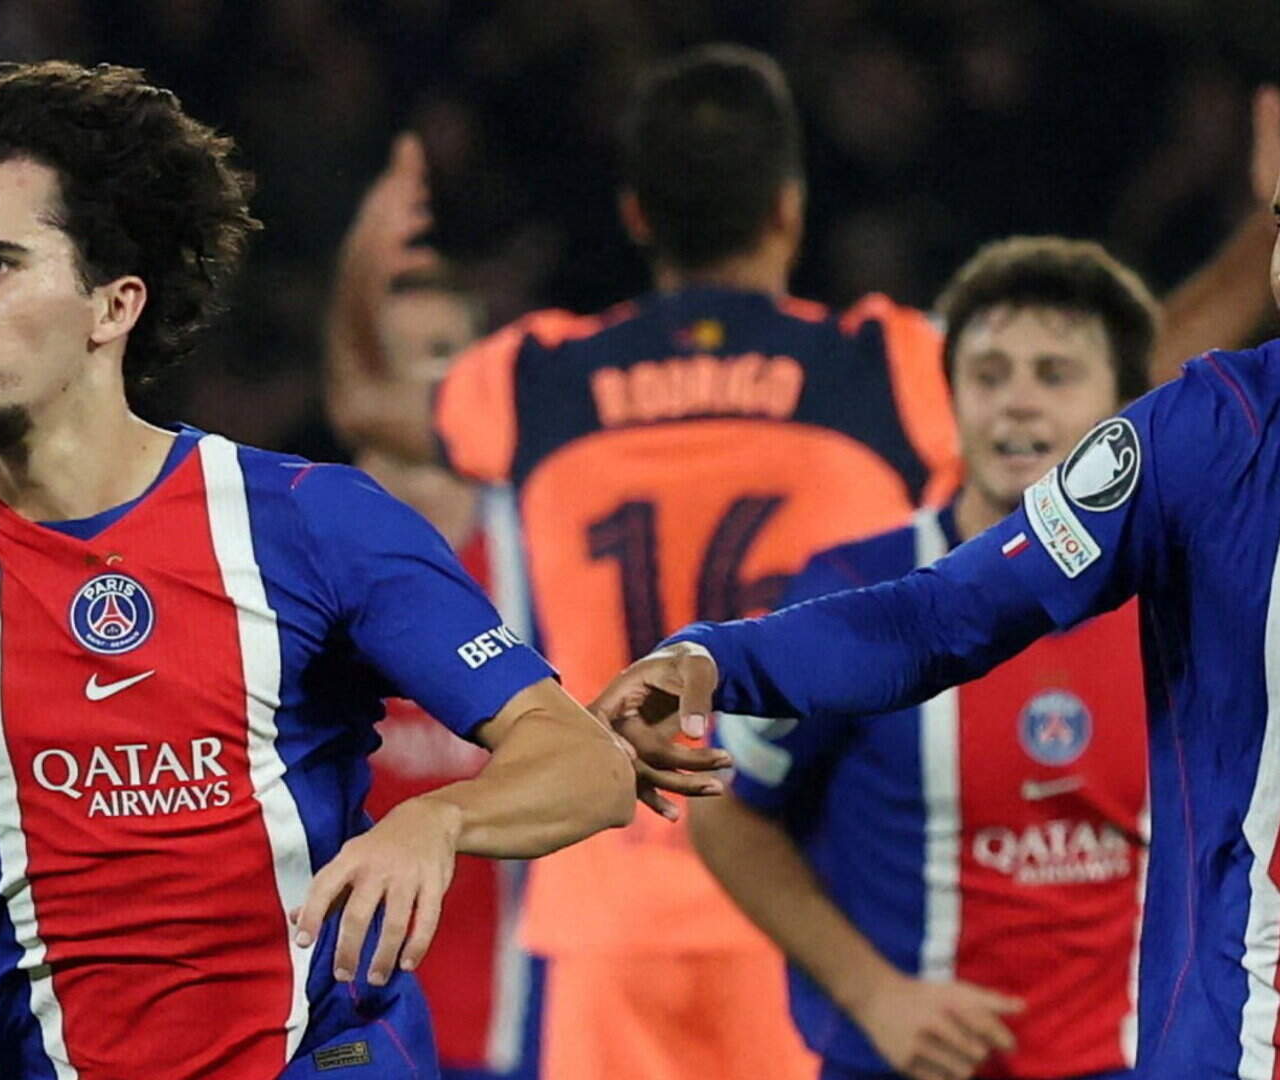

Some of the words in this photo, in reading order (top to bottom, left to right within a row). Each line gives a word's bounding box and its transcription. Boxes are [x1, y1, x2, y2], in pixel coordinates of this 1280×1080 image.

[83, 578, 136, 600] PARIS
[32, 736, 229, 798] QATAR
[88, 781, 231, 818] AIRWAYS
